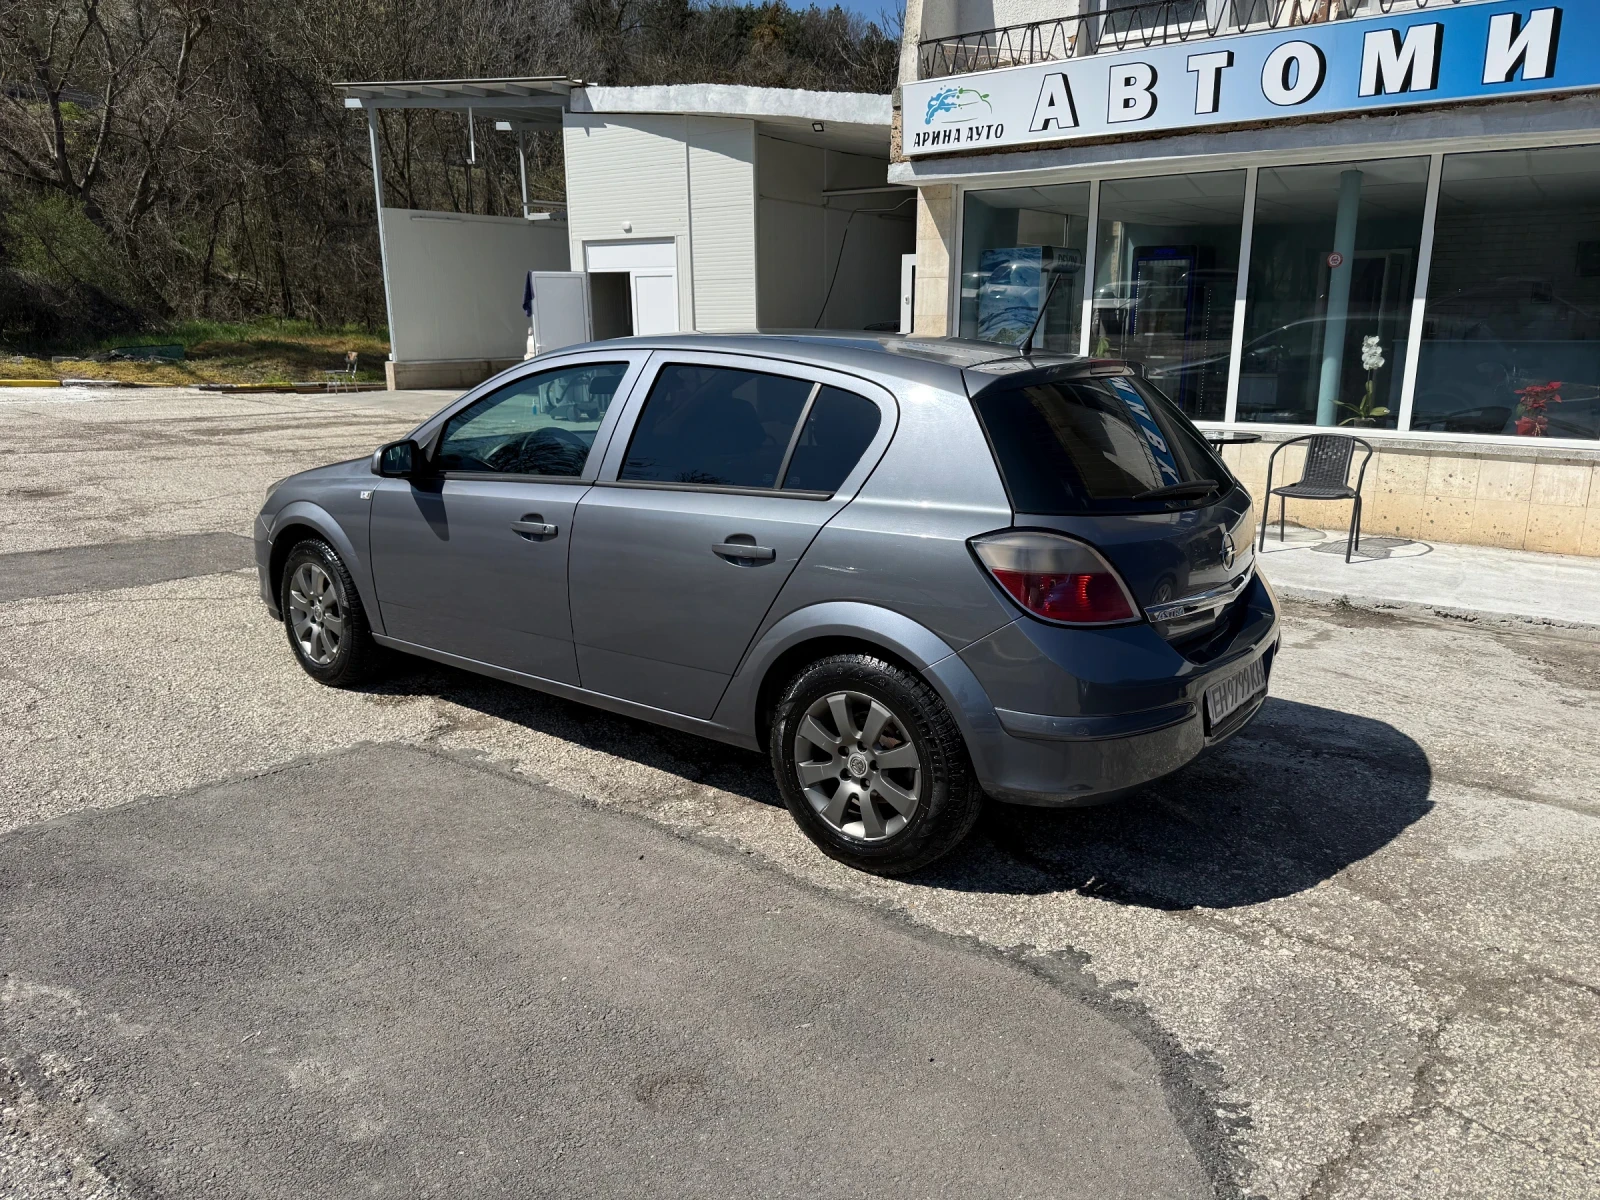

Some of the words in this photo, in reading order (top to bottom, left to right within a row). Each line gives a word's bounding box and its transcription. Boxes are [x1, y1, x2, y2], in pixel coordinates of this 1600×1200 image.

[1028, 6, 1565, 133] АВТОМИ
[913, 128, 961, 148] АРИНА
[965, 123, 1005, 143] АУТО
